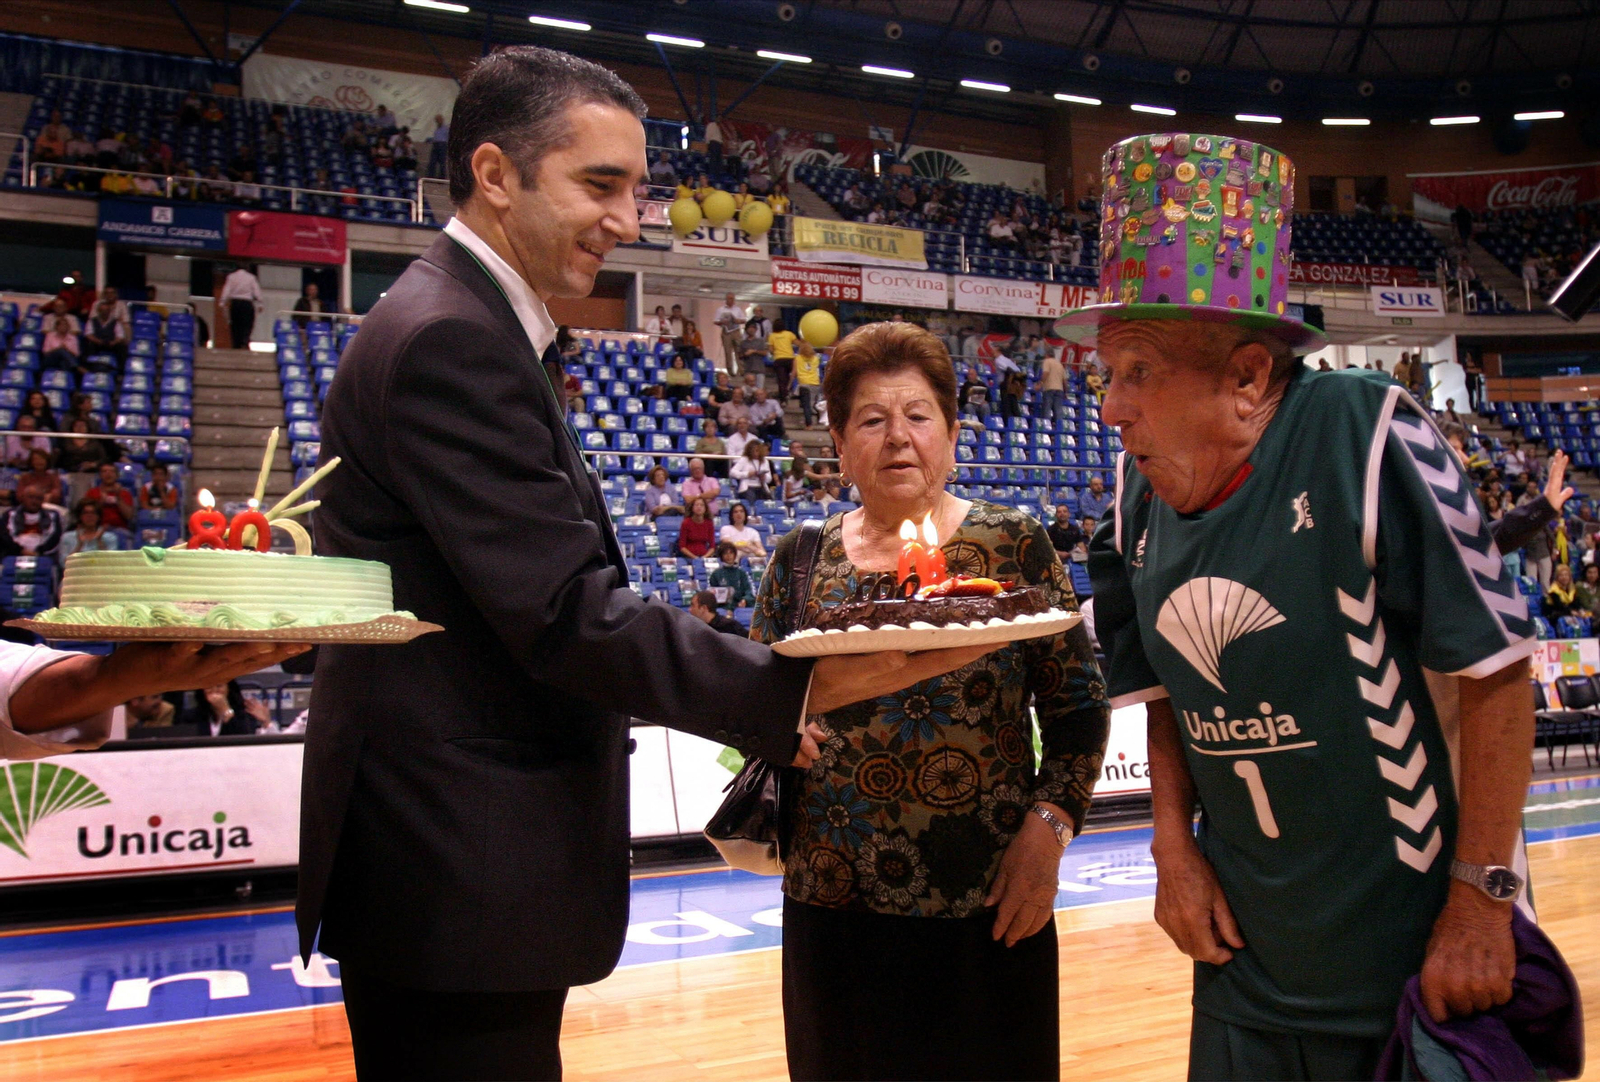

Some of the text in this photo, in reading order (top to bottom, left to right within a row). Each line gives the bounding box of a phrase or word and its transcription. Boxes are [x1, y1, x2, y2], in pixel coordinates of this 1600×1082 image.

[102, 221, 222, 239] ANDAMIOS CABRERA
[824, 230, 899, 254] RECICLA
[809, 271, 861, 286] AUTOMÁTICAS
[867, 271, 945, 291] Corvina
[1310, 265, 1391, 283] GONZALEZ
[776, 281, 860, 300] 952 33 13 99
[958, 279, 1034, 299] Corvina
[1379, 291, 1434, 307] SUR
[1303, 498, 1315, 529] ACB
[1182, 701, 1302, 747] Unicaja
[1234, 760, 1280, 839] 1
[77, 811, 253, 860] Unicaja
